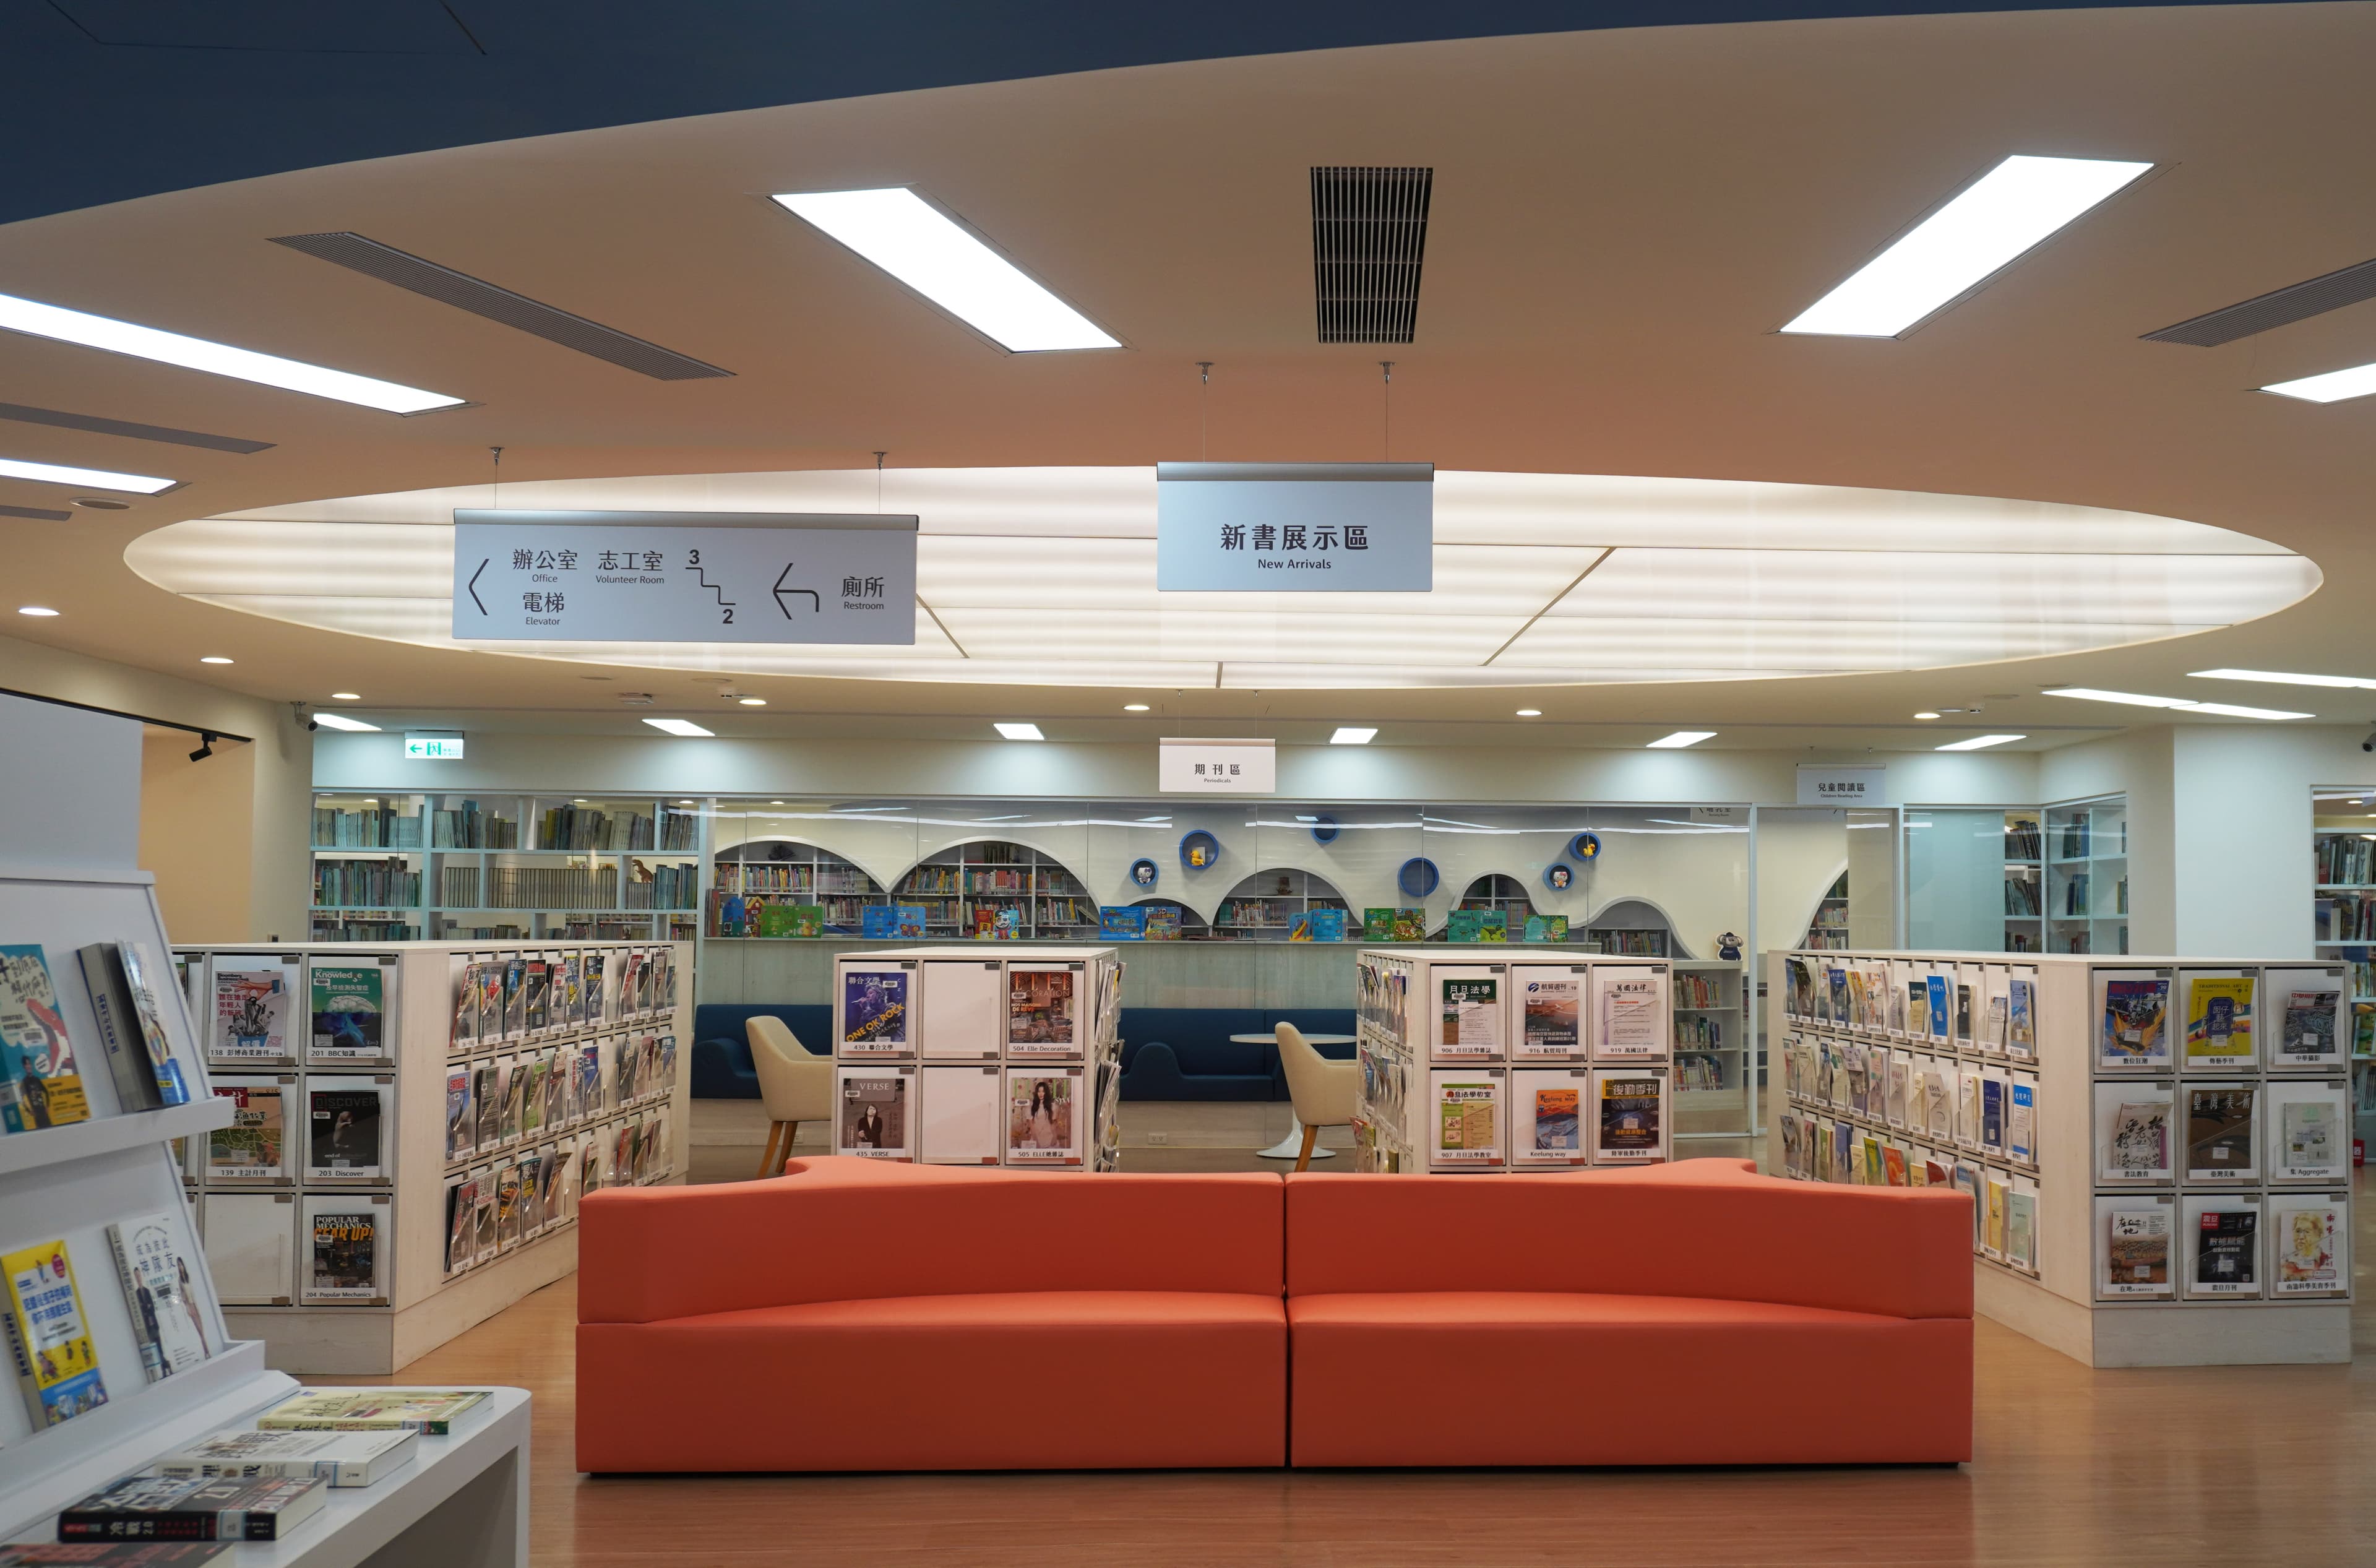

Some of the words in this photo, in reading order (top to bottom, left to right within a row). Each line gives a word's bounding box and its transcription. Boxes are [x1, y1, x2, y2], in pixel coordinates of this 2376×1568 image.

[1220, 523, 1369, 551] 新書展示區
[512, 549, 579, 571] 辦公室
[597, 549, 663, 572] 志工室
[688, 549, 700, 564] 3
[1258, 559, 1284, 569] New
[1287, 559, 1332, 569] Arrivals
[532, 574, 558, 582] Office
[595, 575, 637, 584] Volunteer
[640, 575, 665, 584] Room
[841, 576, 885, 598] 廁所
[522, 592, 565, 613] 電梯
[843, 601, 884, 610] Restroom
[525, 616, 561, 626] Elevator
[722, 608, 734, 624] 2
[1194, 764, 1241, 775] 期刊區
[1818, 782, 1866, 792] 兒童閱讀區
[846, 1027, 867, 1042] ONE
[865, 1018, 880, 1030] OK
[879, 1002, 905, 1021] ROCK
[2298, 1168, 2330, 1176] Aggregate
[316, 1216, 359, 1224] POPULAR
[350, 1227, 374, 1241] UP!
